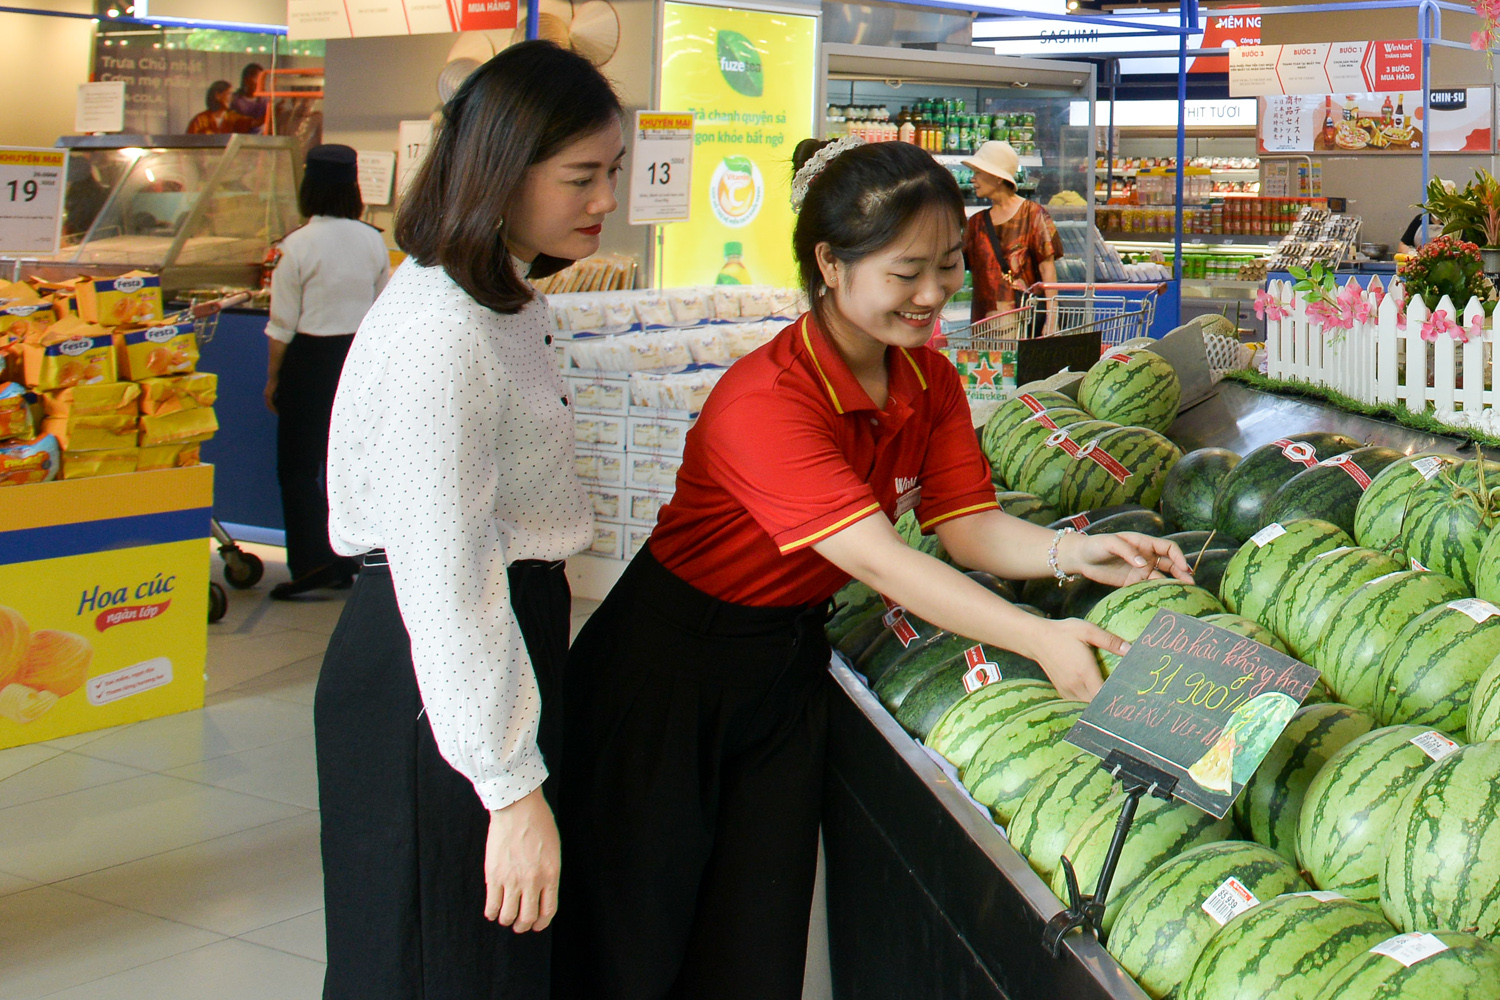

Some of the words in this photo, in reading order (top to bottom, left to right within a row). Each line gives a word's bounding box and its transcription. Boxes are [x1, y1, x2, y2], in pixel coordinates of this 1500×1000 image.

[468, 3, 486, 13] MUA
[1040, 29, 1099, 44] SASHIMI
[1241, 49, 1259, 58] BƯỚC
[1293, 47, 1311, 56] BƯỚC
[1339, 45, 1357, 54] BƯỚC
[1384, 43, 1413, 53] WinMart
[1391, 63, 1410, 73] BƯỚC
[1396, 72, 1415, 81] HÀNG
[1430, 91, 1465, 103] CHIN-SU
[708, 109, 740, 122] chanh
[741, 110, 773, 126] quyện
[775, 110, 786, 124] sả
[1210, 104, 1241, 118] TƯƠI
[694, 132, 715, 146] gon
[718, 128, 743, 143] khỏe
[746, 129, 763, 144] bất
[765, 131, 784, 148] ngờ
[408, 143, 420, 159] 17
[648, 162, 670, 185] 13
[7, 180, 38, 202] 19
[117, 279, 142, 288] Festa
[148, 327, 174, 338] Festa
[62, 341, 89, 351] Festa
[76, 585, 129, 615] Hoa
[134, 572, 177, 599] cúc
[106, 607, 137, 624] ngàn
[139, 605, 159, 618] lớp
[1222, 638, 1275, 699] không
[1137, 655, 1183, 696] 31
